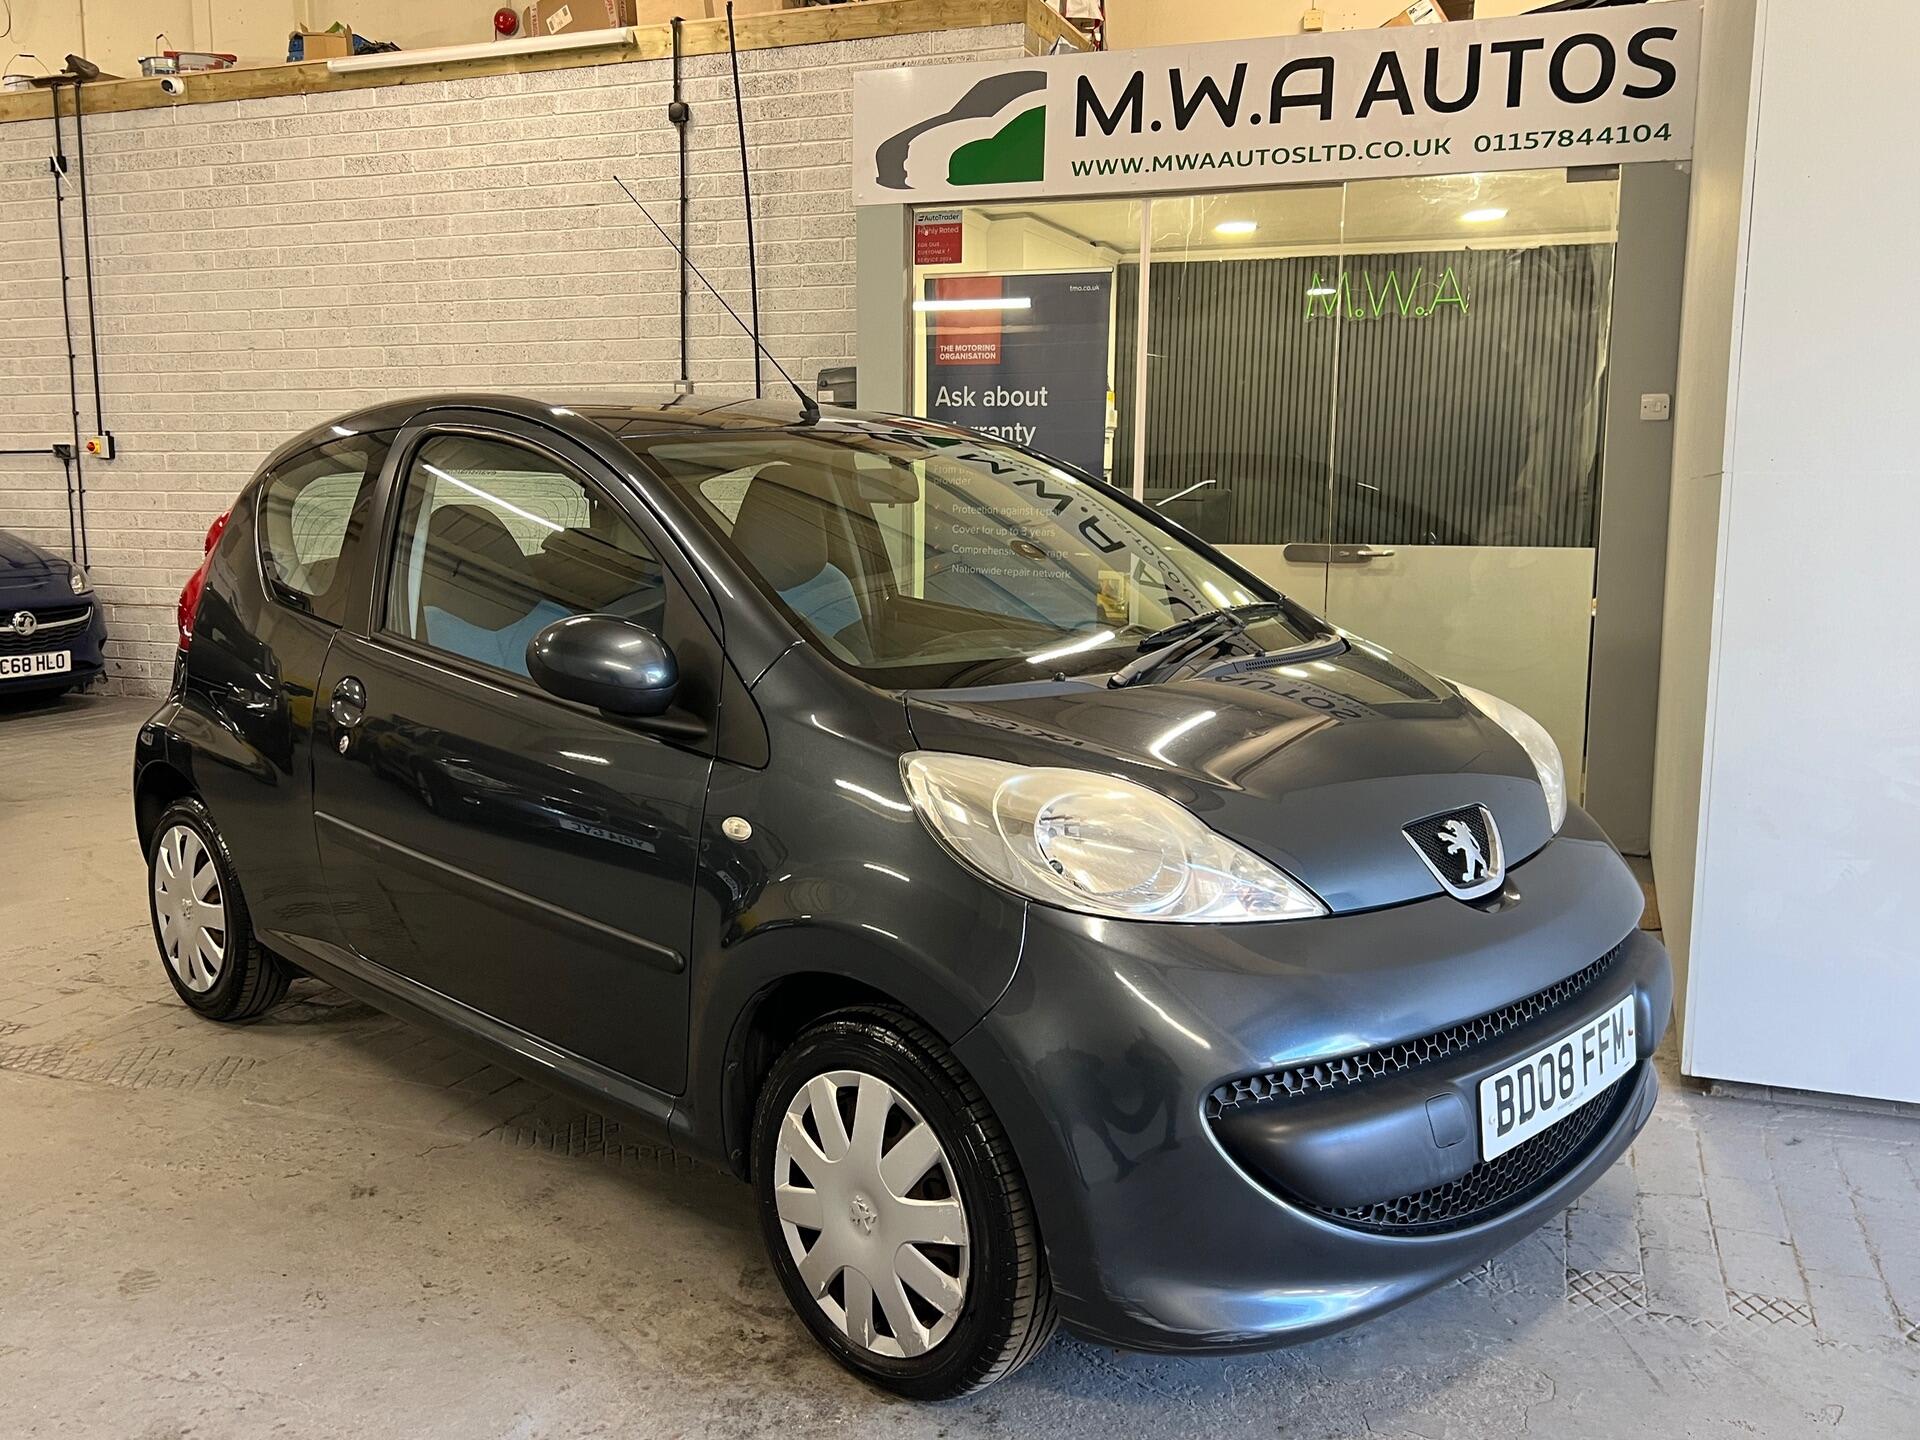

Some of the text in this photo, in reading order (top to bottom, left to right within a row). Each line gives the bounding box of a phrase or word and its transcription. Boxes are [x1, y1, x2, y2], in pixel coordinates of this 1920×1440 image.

[1074, 27, 1678, 137] M.W.A AUTOS
[1071, 123, 1672, 177] WWW.MWAAUTOSLTD.CO.UK 01157844104
[1069, 284, 1100, 292] tmo.co.uk
[1306, 266, 1469, 320] M.W.A
[955, 344, 996, 352] MOTORING
[939, 352, 996, 361] ORGANISATION
[935, 385, 1049, 407] Ask about
[952, 504, 998, 515] Protection
[1001, 506, 1033, 517] against
[952, 525, 979, 535] Cover
[982, 526, 994, 536] for
[996, 528, 1008, 538] up
[1009, 527, 1019, 535] to
[1030, 529, 1056, 538] years
[952, 565, 1071, 579] Nationwide repair network
[36, 653, 65, 672] HLO
[1494, 1007, 1626, 1138] BD08 FFM
